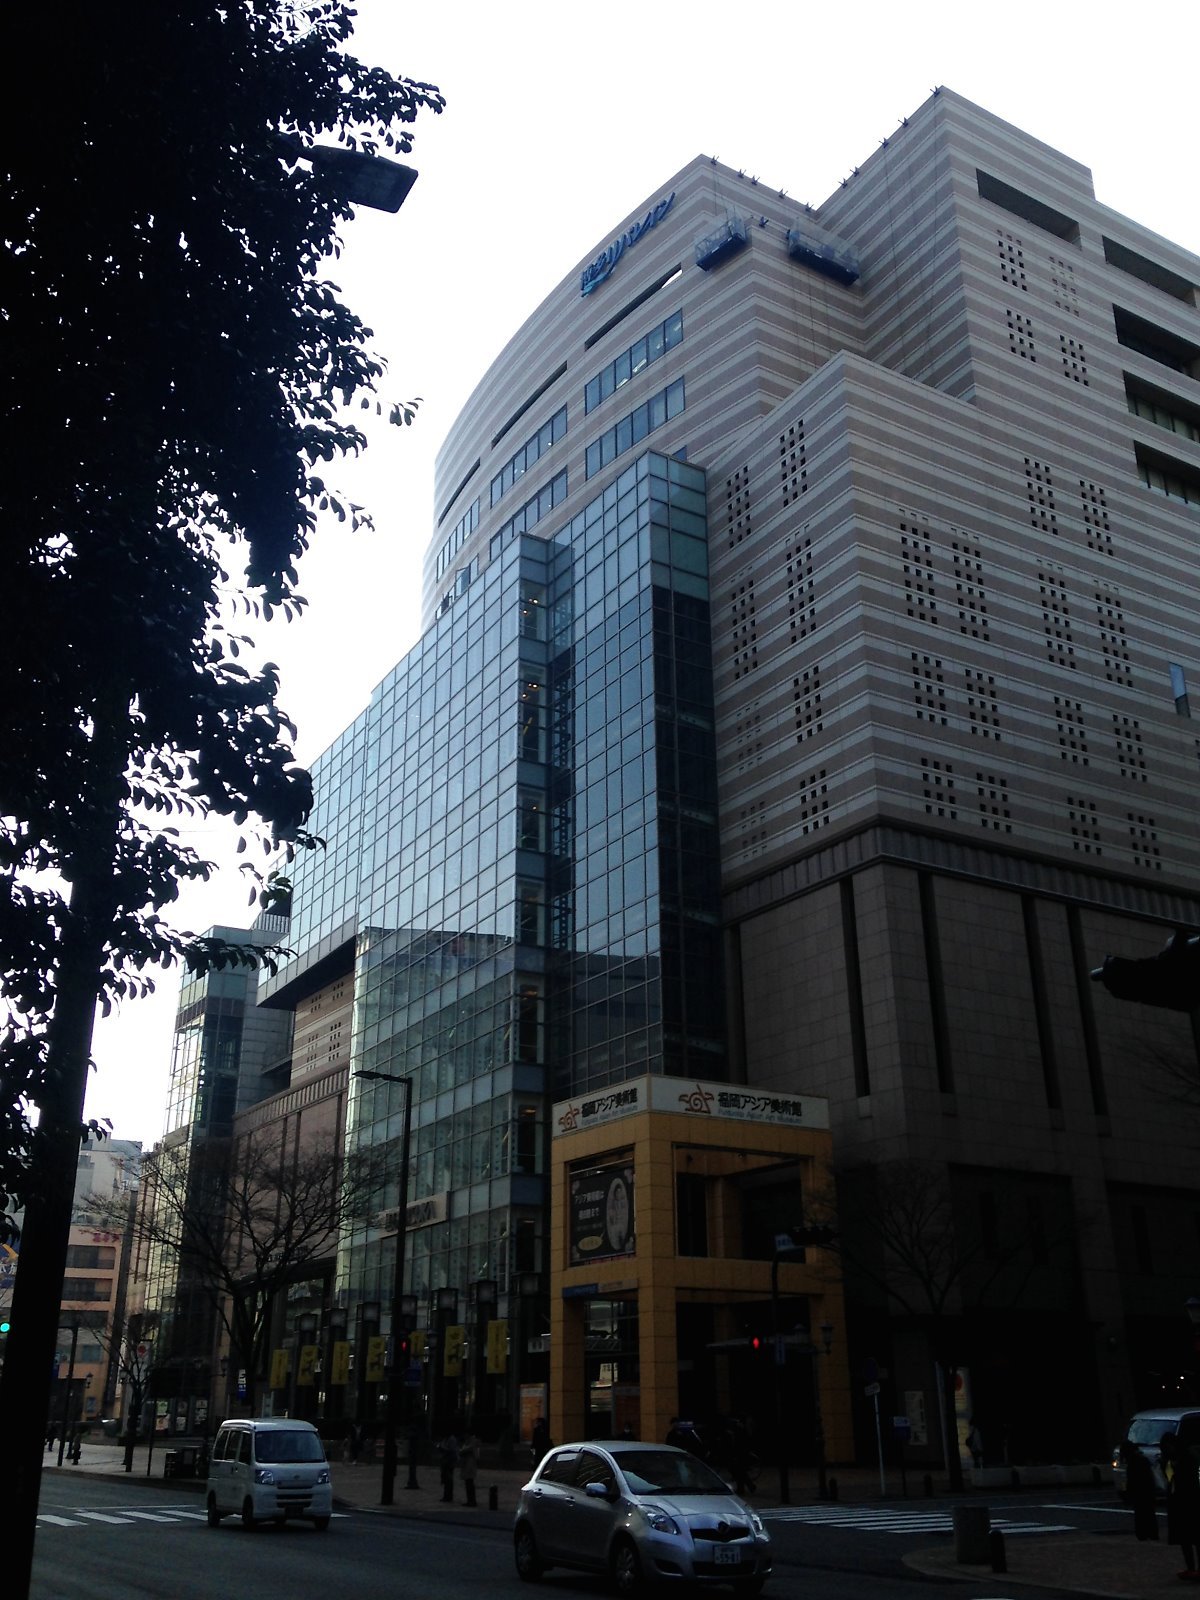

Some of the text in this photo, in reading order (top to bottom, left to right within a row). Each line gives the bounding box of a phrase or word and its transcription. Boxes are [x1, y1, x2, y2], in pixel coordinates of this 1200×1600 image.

[717, 1091, 802, 1117] 福岡アジア美術館
